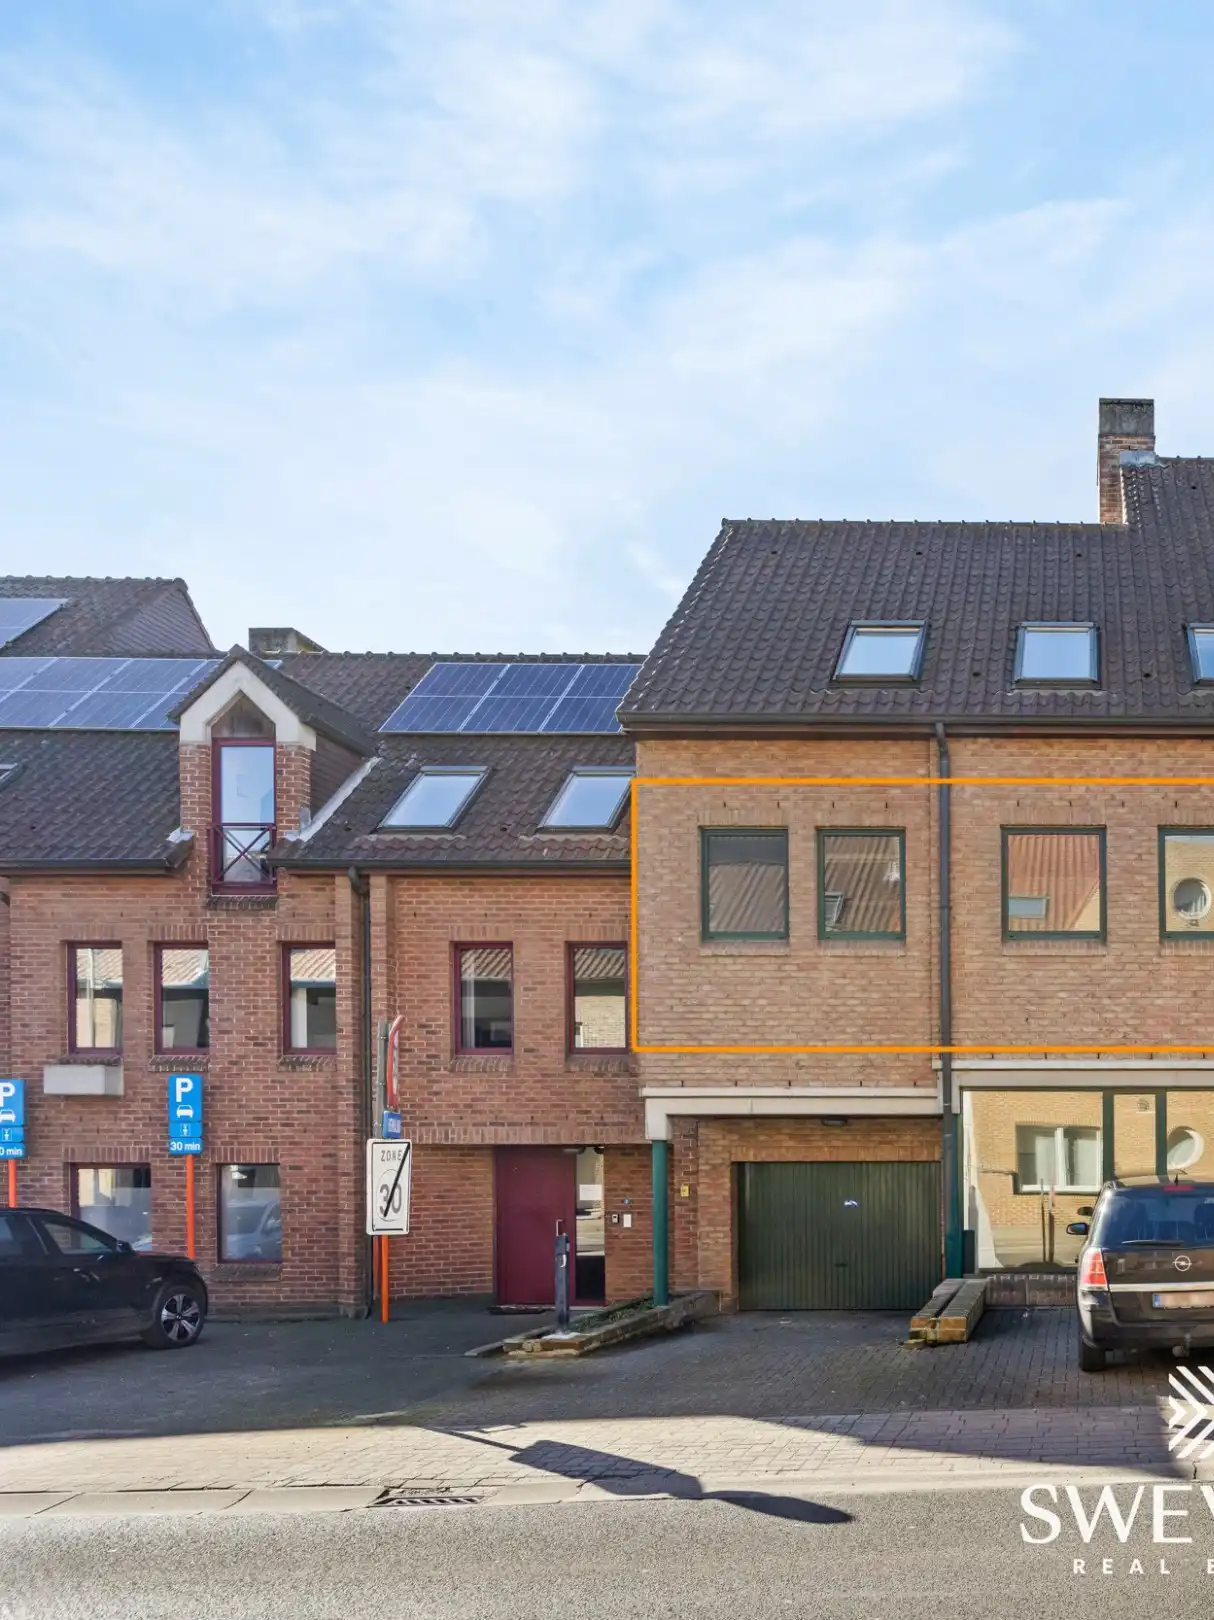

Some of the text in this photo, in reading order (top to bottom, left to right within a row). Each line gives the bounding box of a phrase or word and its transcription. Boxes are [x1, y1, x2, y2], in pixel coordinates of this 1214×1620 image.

[0, 1082, 16, 1108] P
[176, 1077, 193, 1103] P
[6, 1147, 22, 1156] min
[170, 1141, 200, 1151] 30 min
[380, 1150, 402, 1162] ZONE
[379, 1183, 402, 1216] 30
